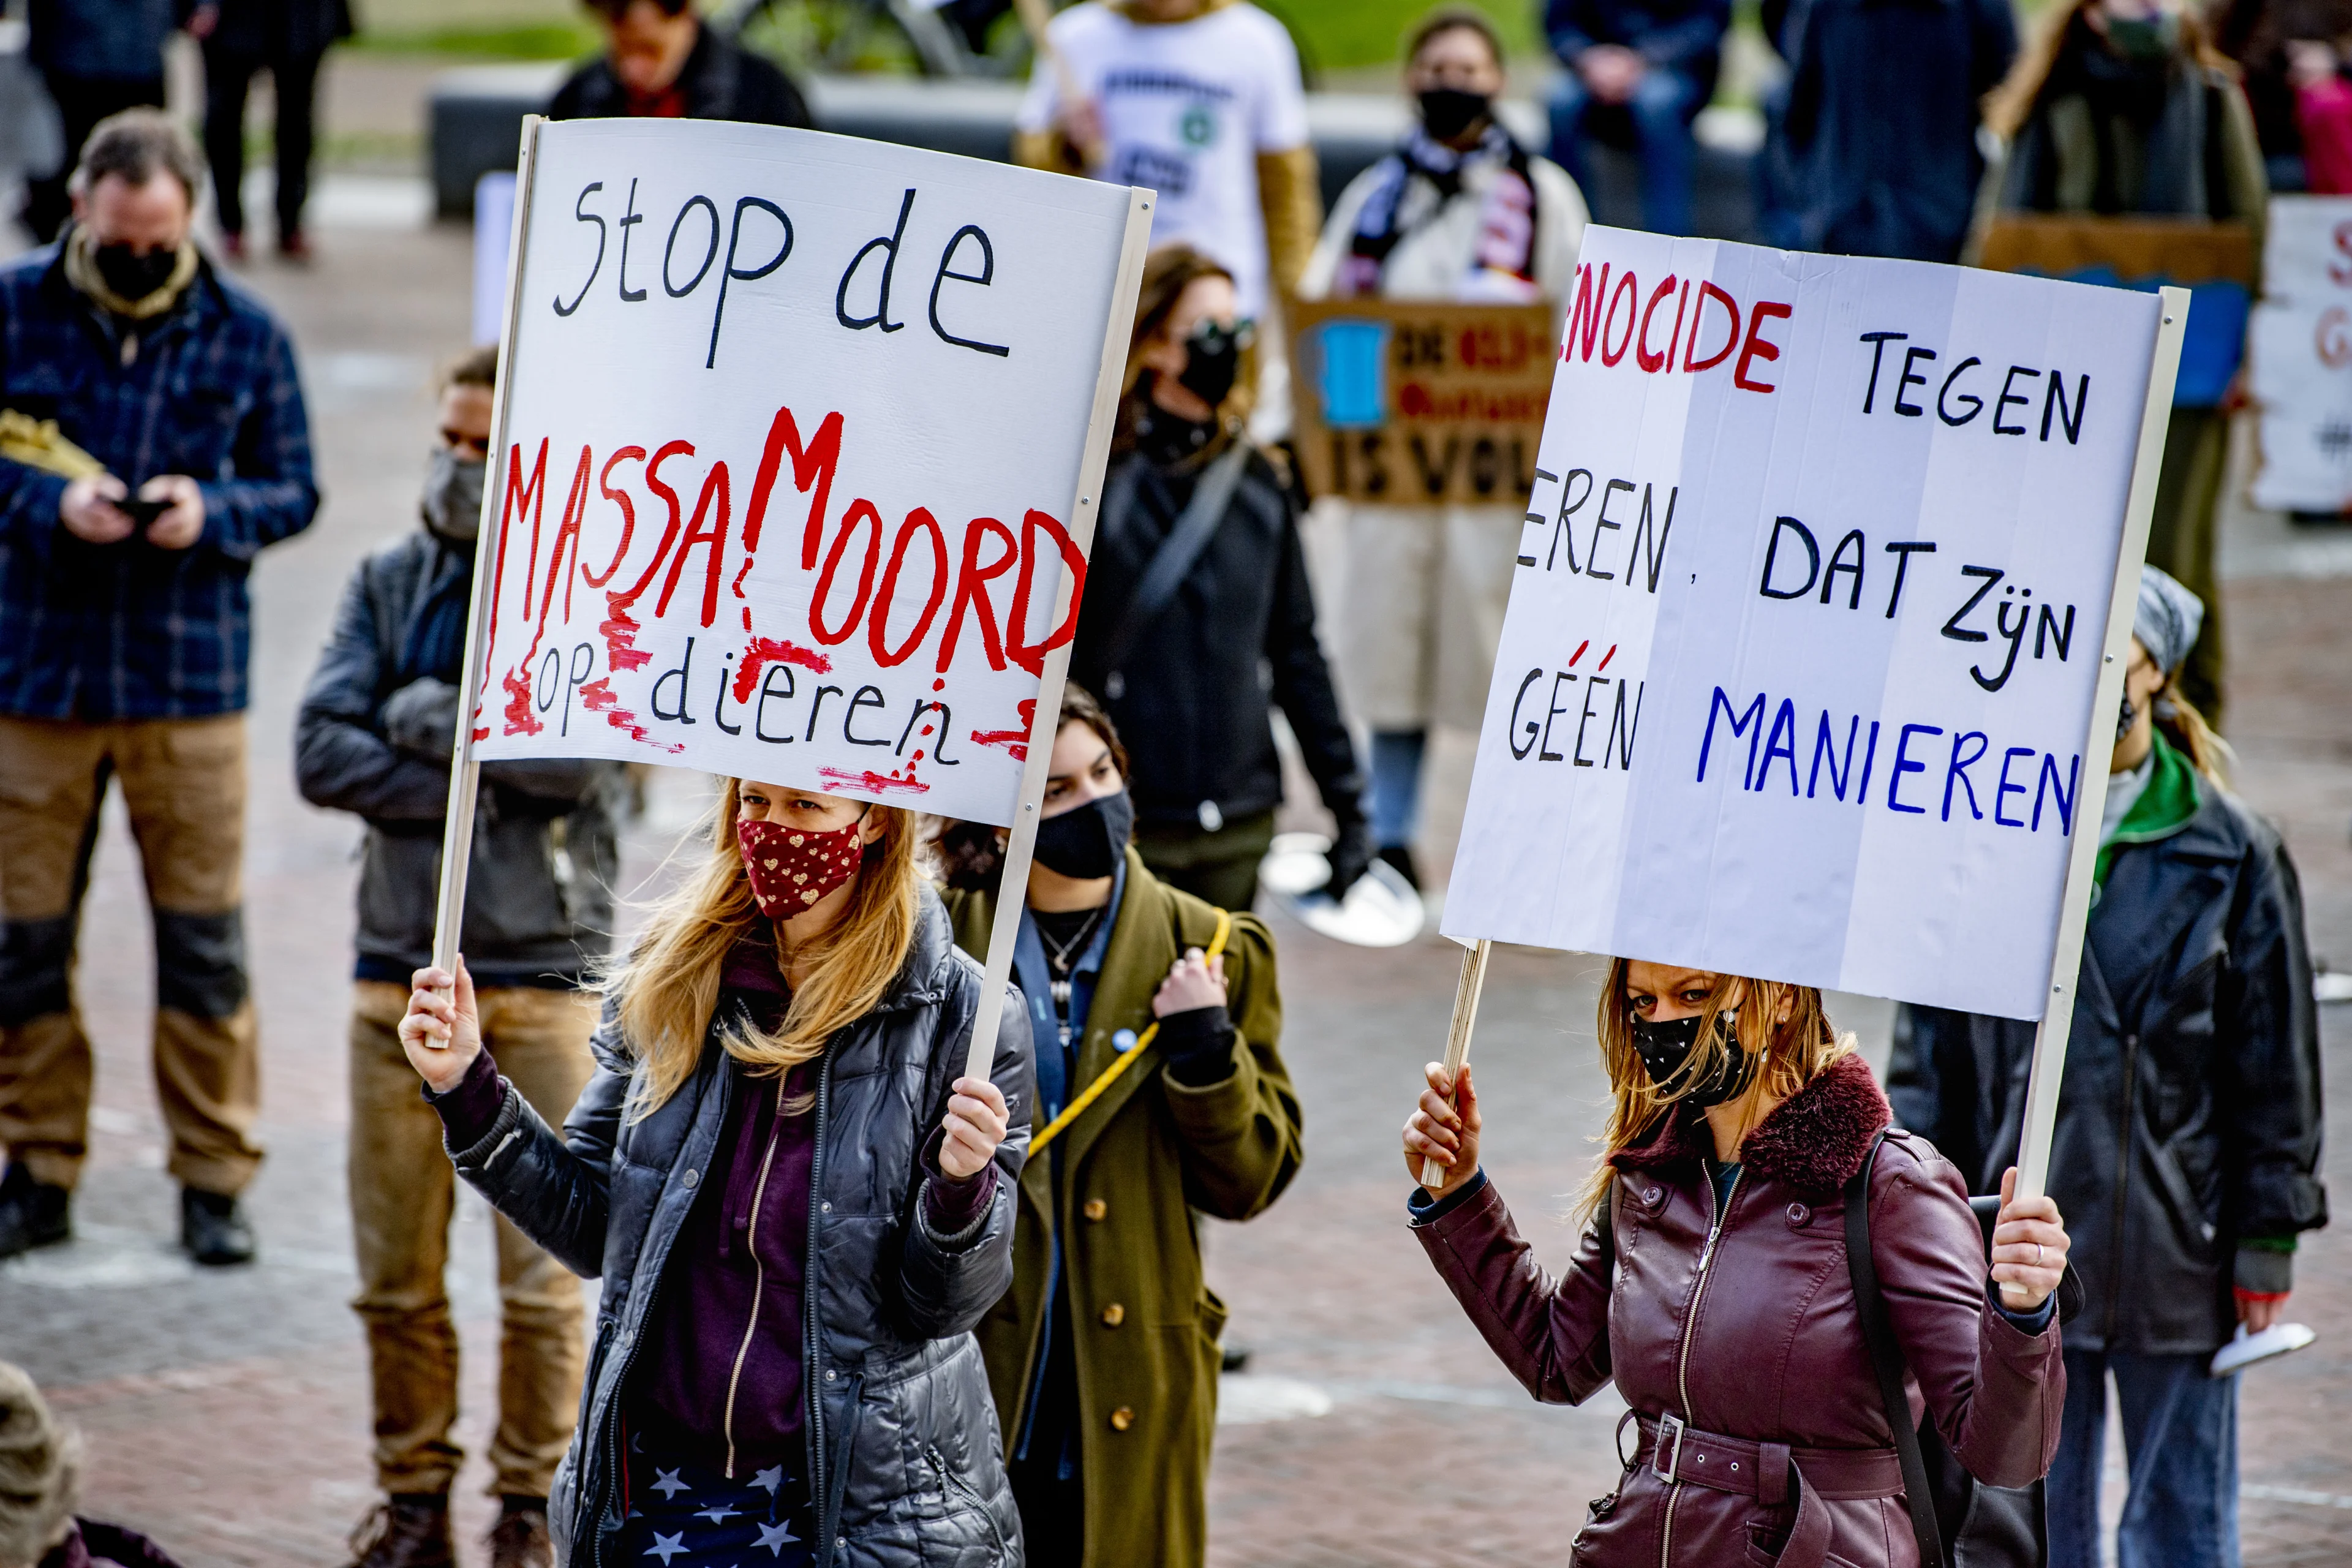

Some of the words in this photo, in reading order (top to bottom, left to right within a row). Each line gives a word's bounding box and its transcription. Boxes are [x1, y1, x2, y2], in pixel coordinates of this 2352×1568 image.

[553, 178, 793, 369] Stop
[836, 189, 1009, 357] de
[1559, 263, 1792, 393] NOCIDE
[1860, 332, 2090, 445] TEGEN
[489, 406, 1087, 677] MASSAMOORD
[1760, 516, 1936, 619] DAT
[538, 643, 594, 736] op
[651, 637, 960, 765] dieren
[1510, 641, 1644, 771] GÉÉN
[1697, 685, 2079, 836] MANIEREN
